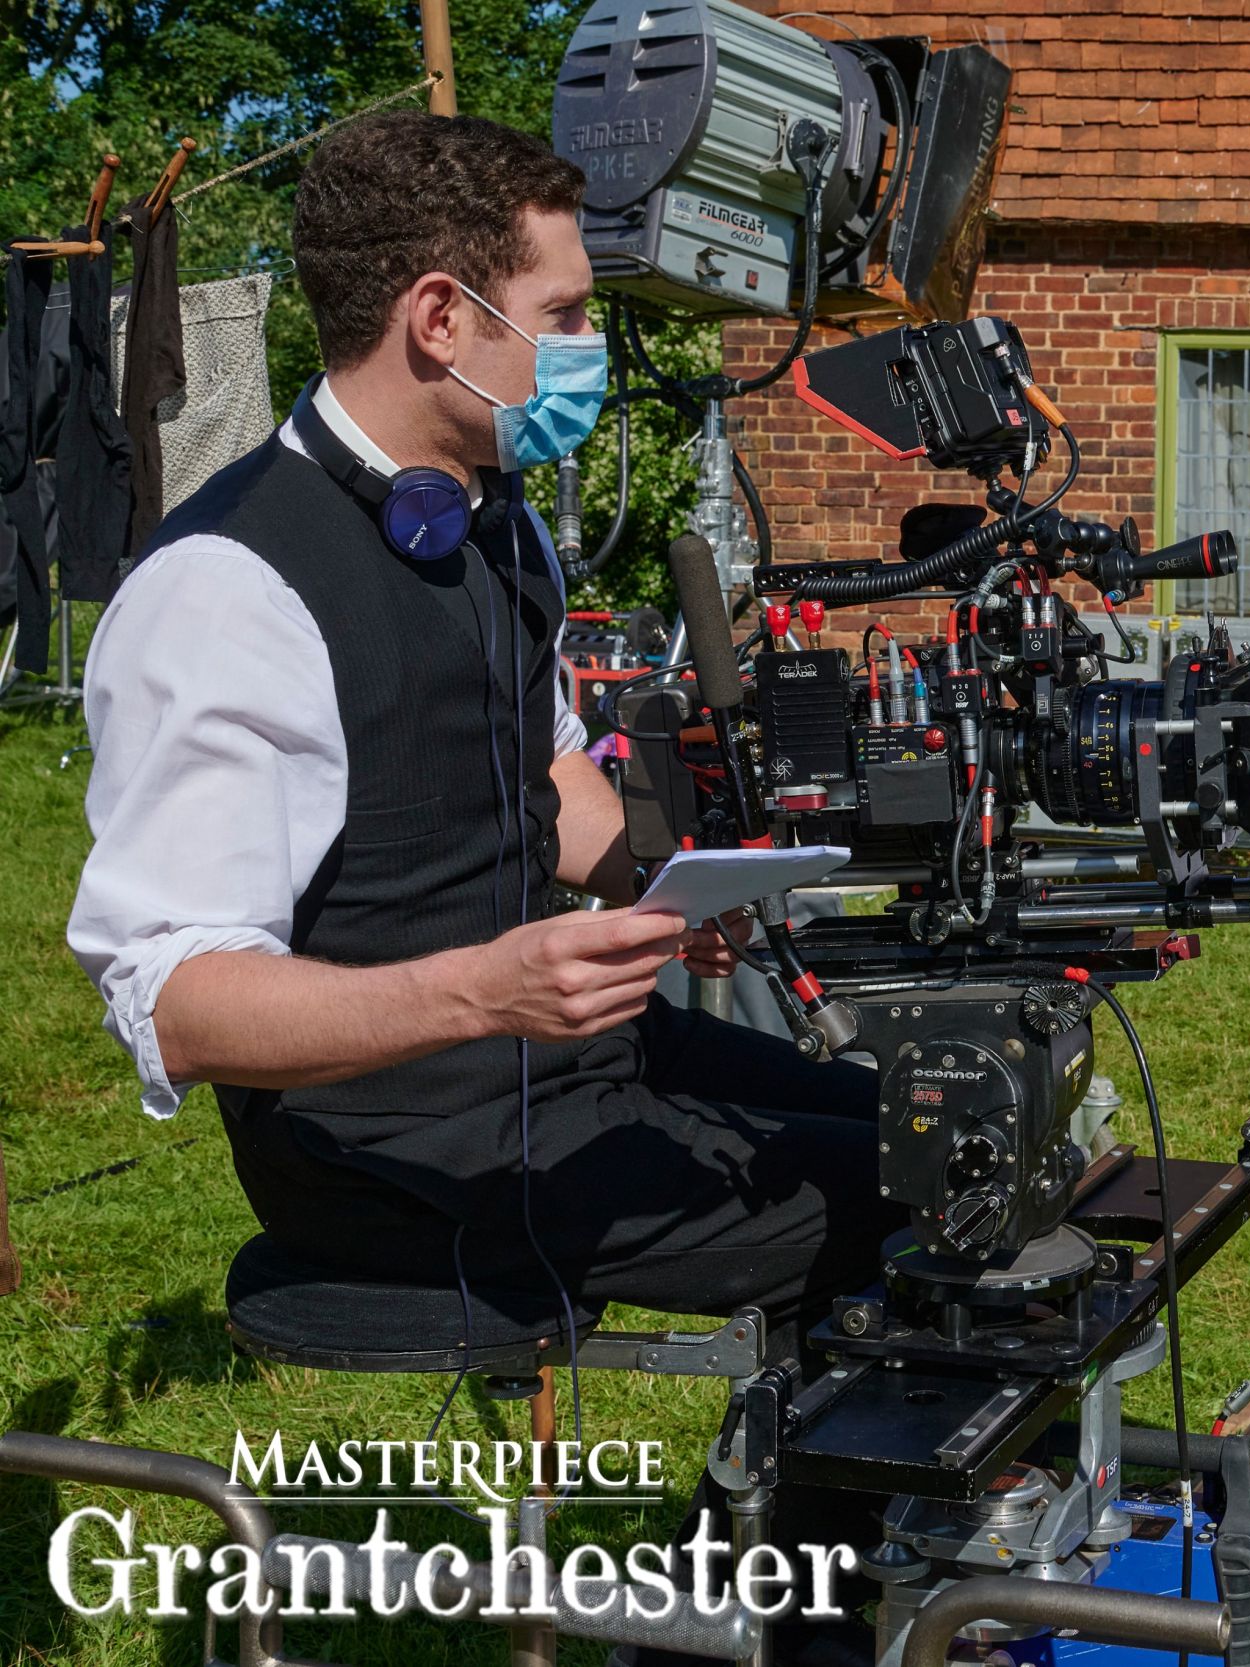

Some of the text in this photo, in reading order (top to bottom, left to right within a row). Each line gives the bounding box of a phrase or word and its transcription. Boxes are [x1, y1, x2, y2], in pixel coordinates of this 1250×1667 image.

[730, 230, 764, 248] 6000
[408, 523, 428, 550] SONY
[778, 669, 818, 679] TERADEK
[912, 1069, 984, 1080] oconnor
[1106, 1457, 1118, 1478] TSF
